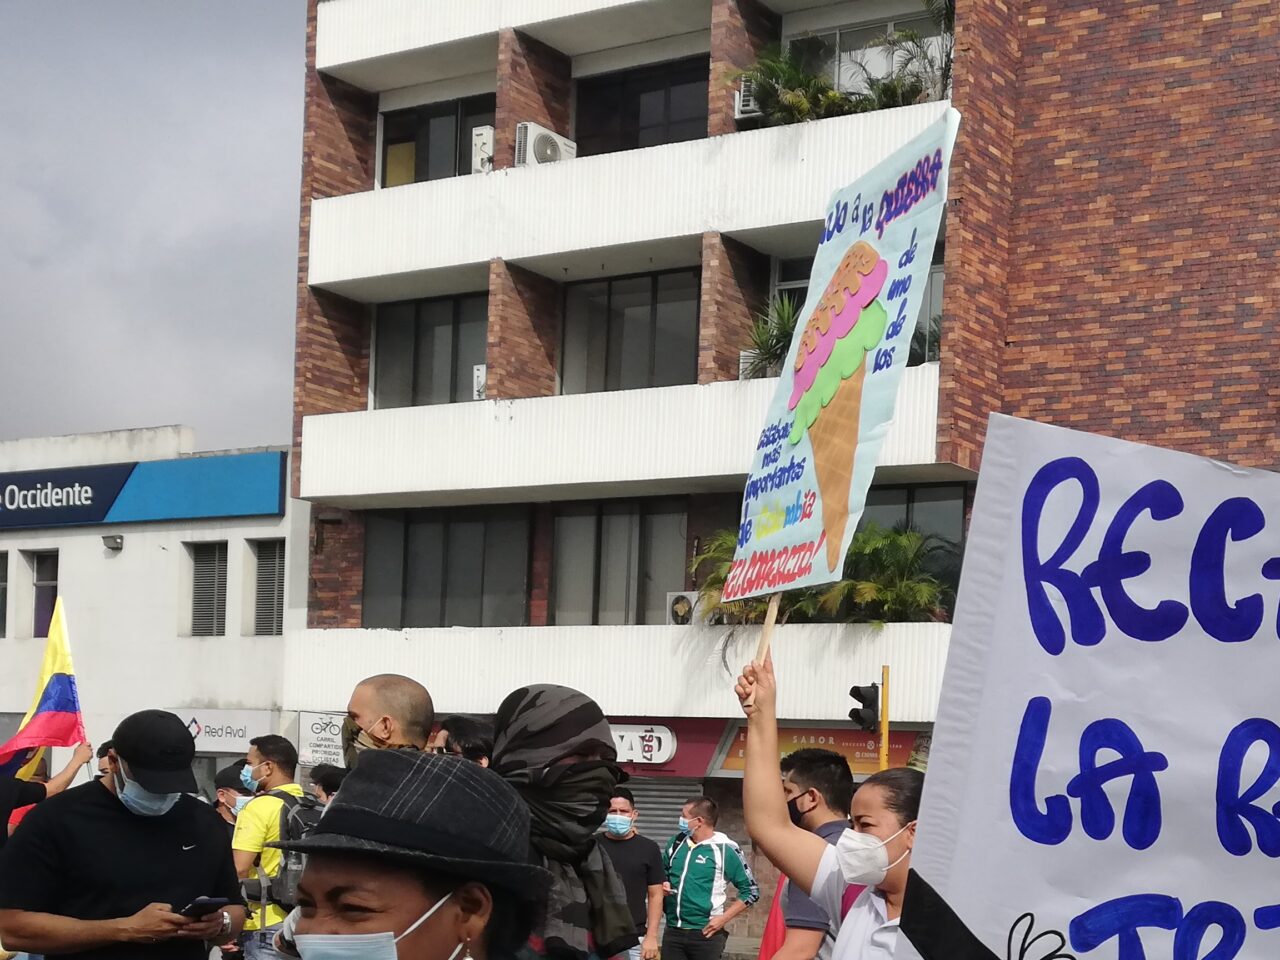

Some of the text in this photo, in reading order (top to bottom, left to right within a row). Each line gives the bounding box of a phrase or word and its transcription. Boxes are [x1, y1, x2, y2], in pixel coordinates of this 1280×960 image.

[898, 227, 918, 269] de
[885, 297, 908, 340] de
[5, 482, 93, 510] Occidente
[204, 725, 247, 739] Red Aval
[643, 727, 655, 762] 1987
[792, 735, 835, 745] SABOR
[1010, 697, 1168, 851] LA
